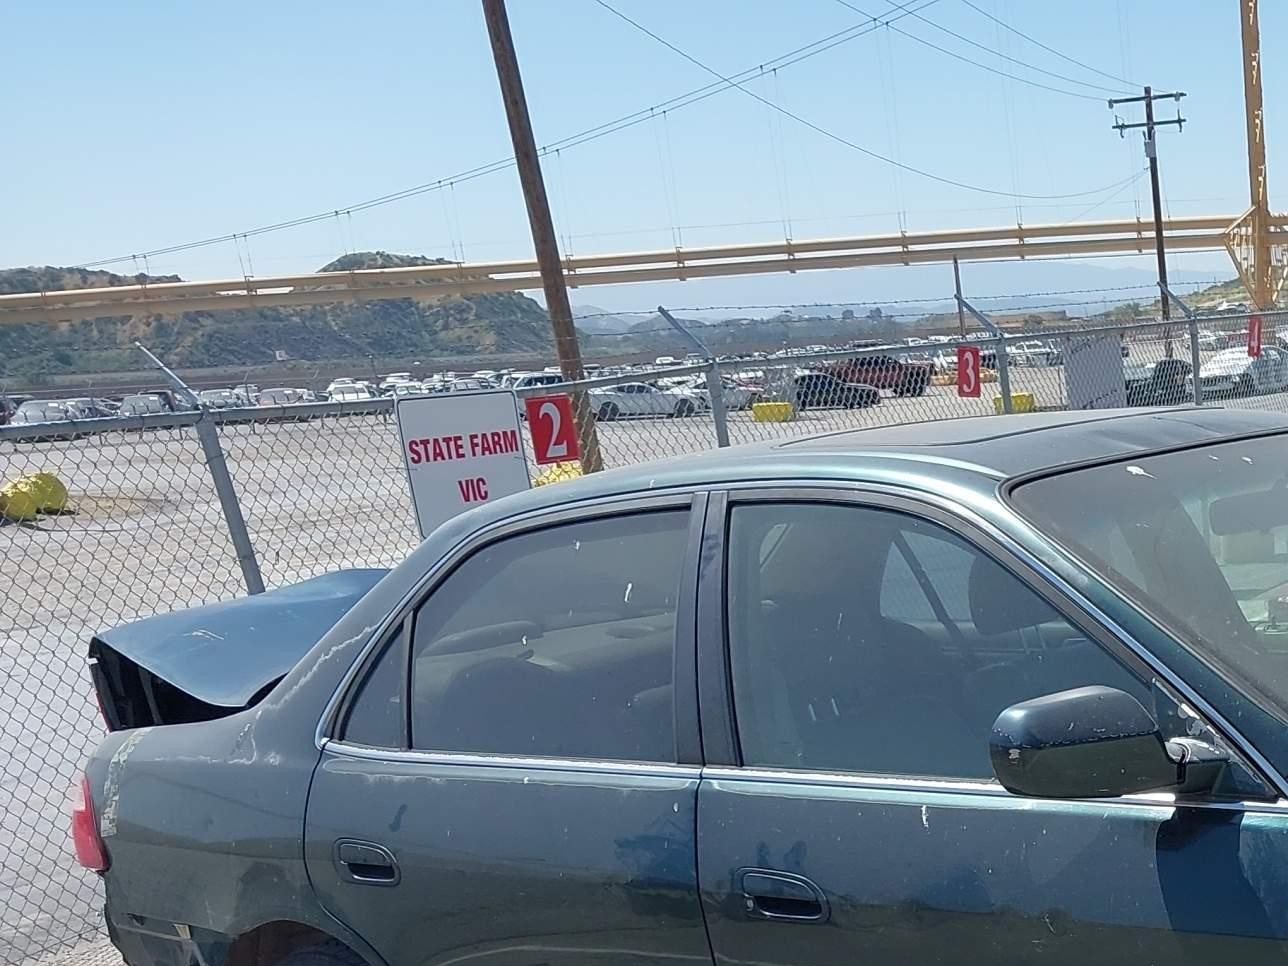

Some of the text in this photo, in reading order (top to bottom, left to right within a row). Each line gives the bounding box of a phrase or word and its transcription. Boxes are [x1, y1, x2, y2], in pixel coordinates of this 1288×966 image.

[963, 351, 975, 392] 3
[408, 429, 519, 465] STATE FARM
[539, 402, 568, 458] 2
[458, 477, 489, 503] VIC
